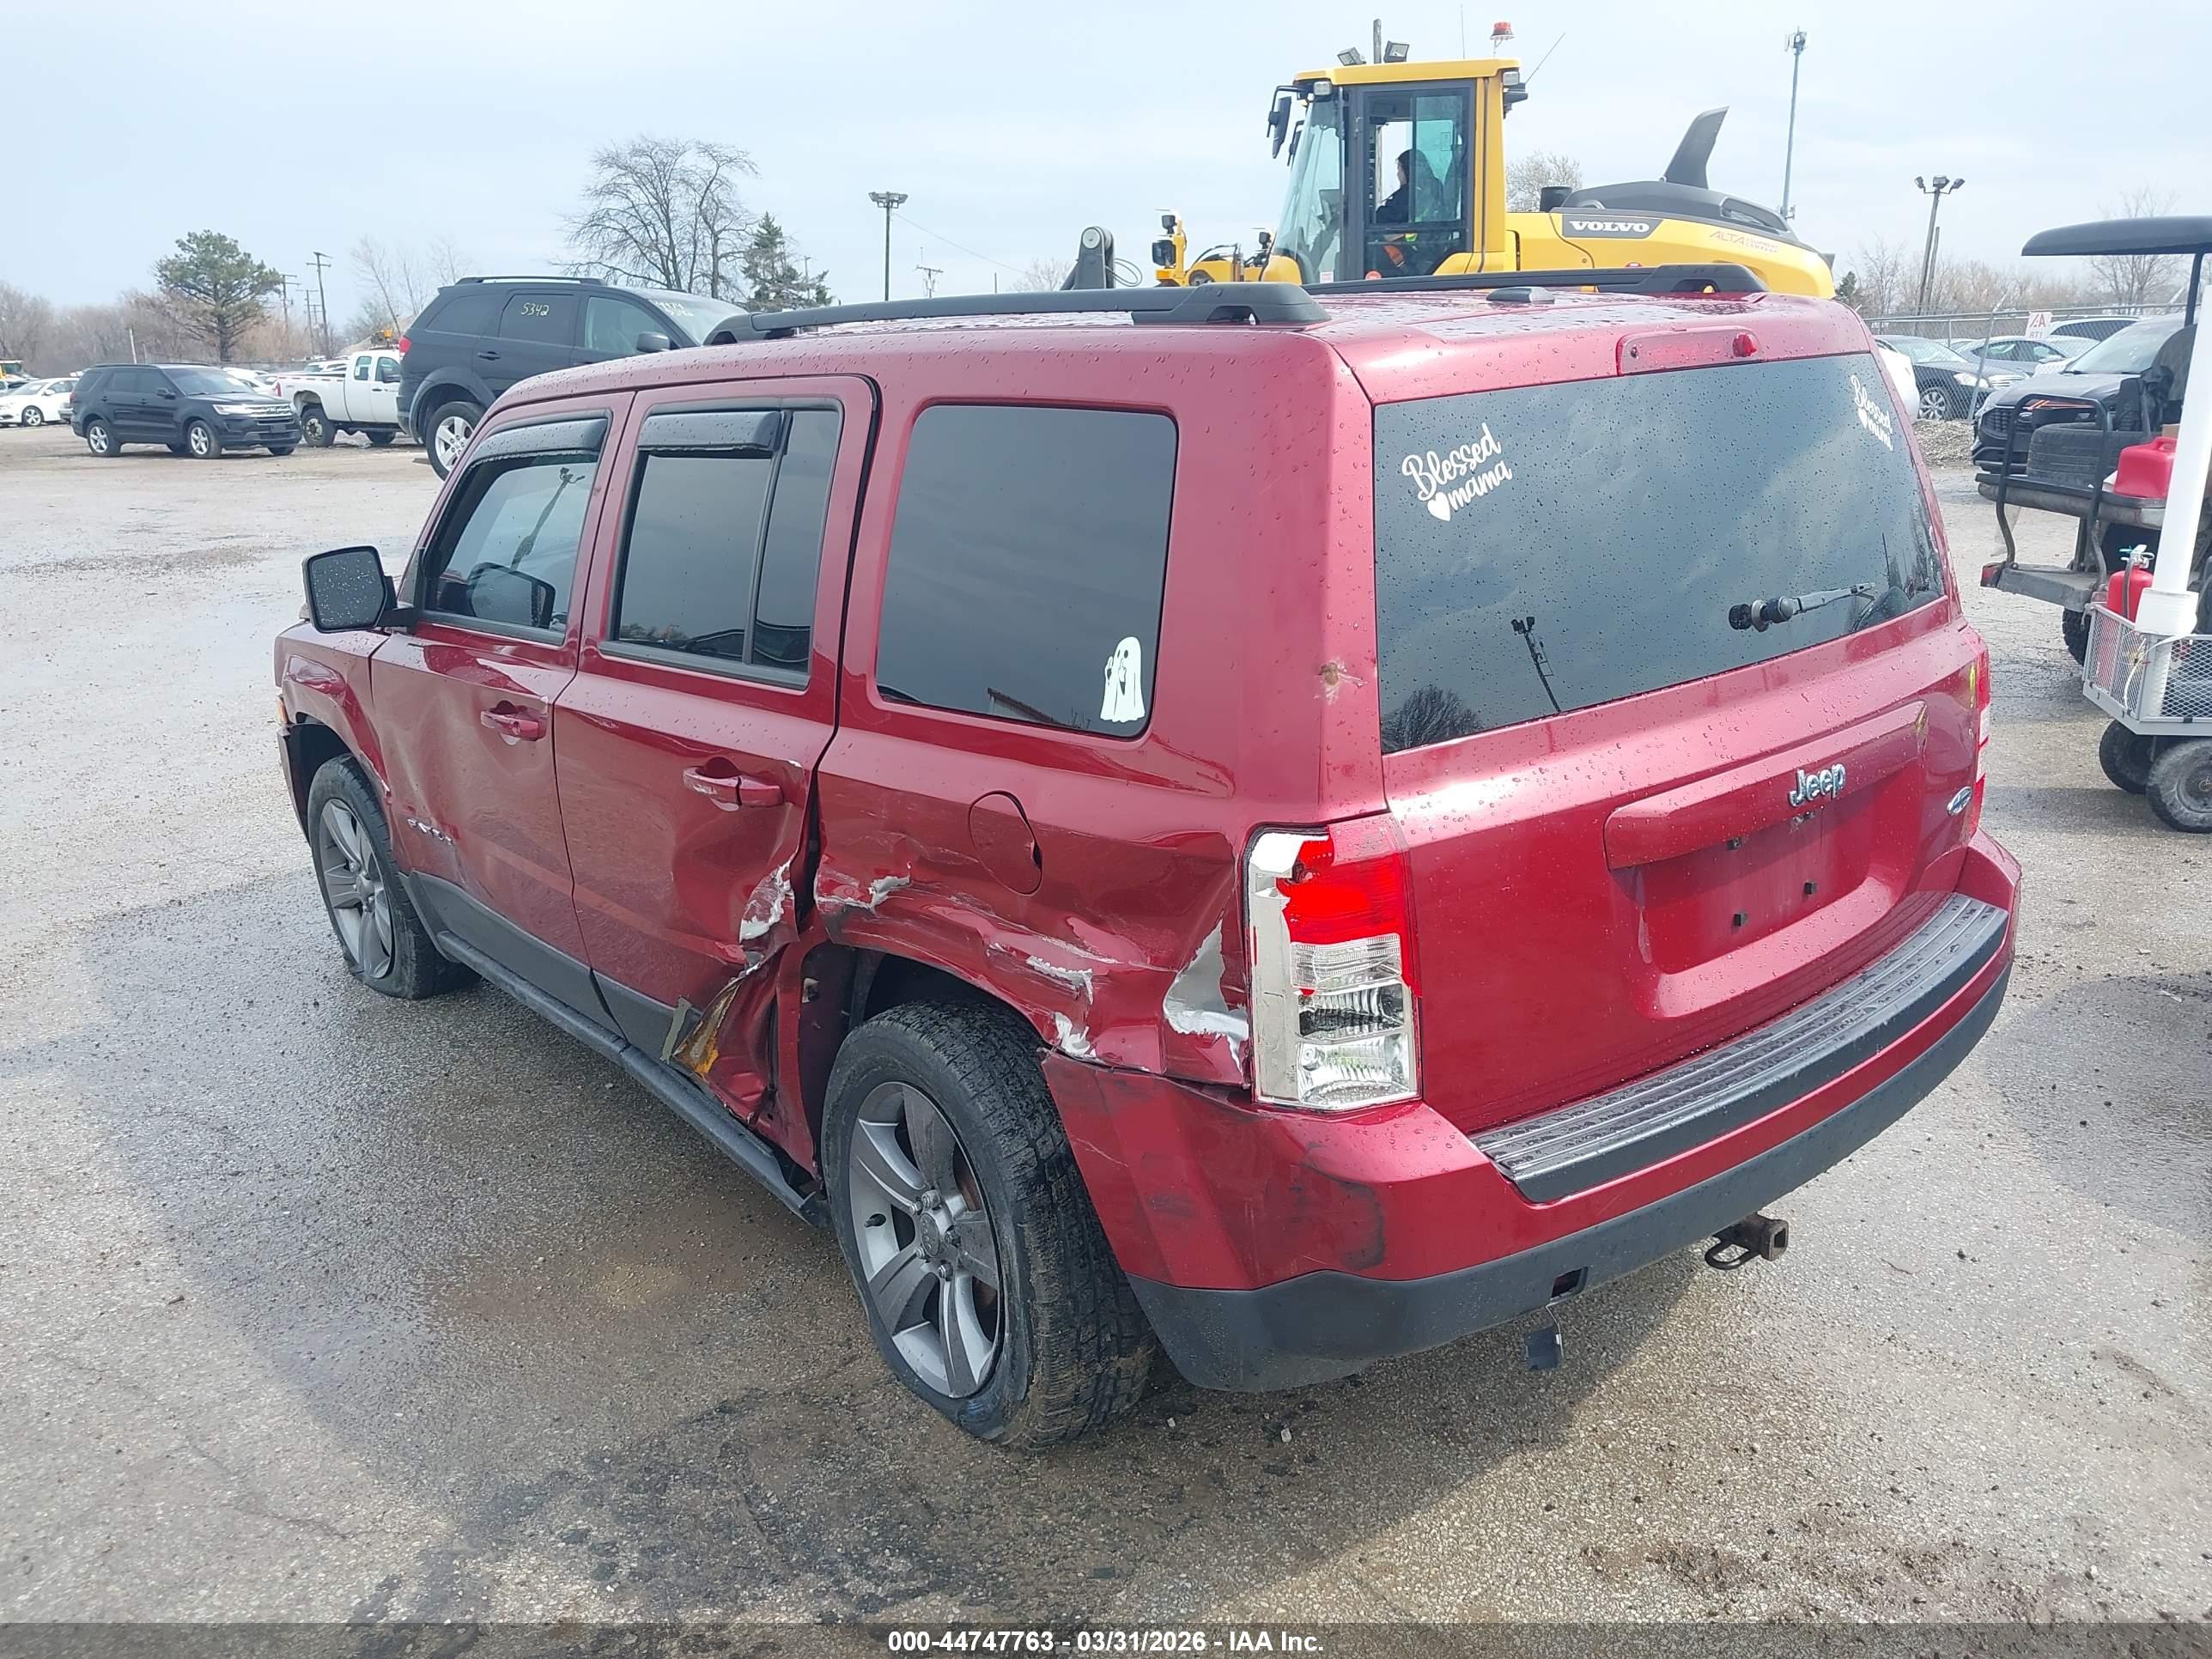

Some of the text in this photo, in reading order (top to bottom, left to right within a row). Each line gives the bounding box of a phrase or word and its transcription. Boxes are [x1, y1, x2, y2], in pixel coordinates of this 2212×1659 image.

[1569, 220, 1650, 233] VOLVO
[1709, 230, 1745, 246] ALTA
[521, 302, 550, 316] 5342
[1850, 374, 1893, 434] Blessed
[1401, 422, 1502, 501] Blessed
[1448, 460, 1513, 511] mama
[1788, 763, 1846, 807] Jeep
